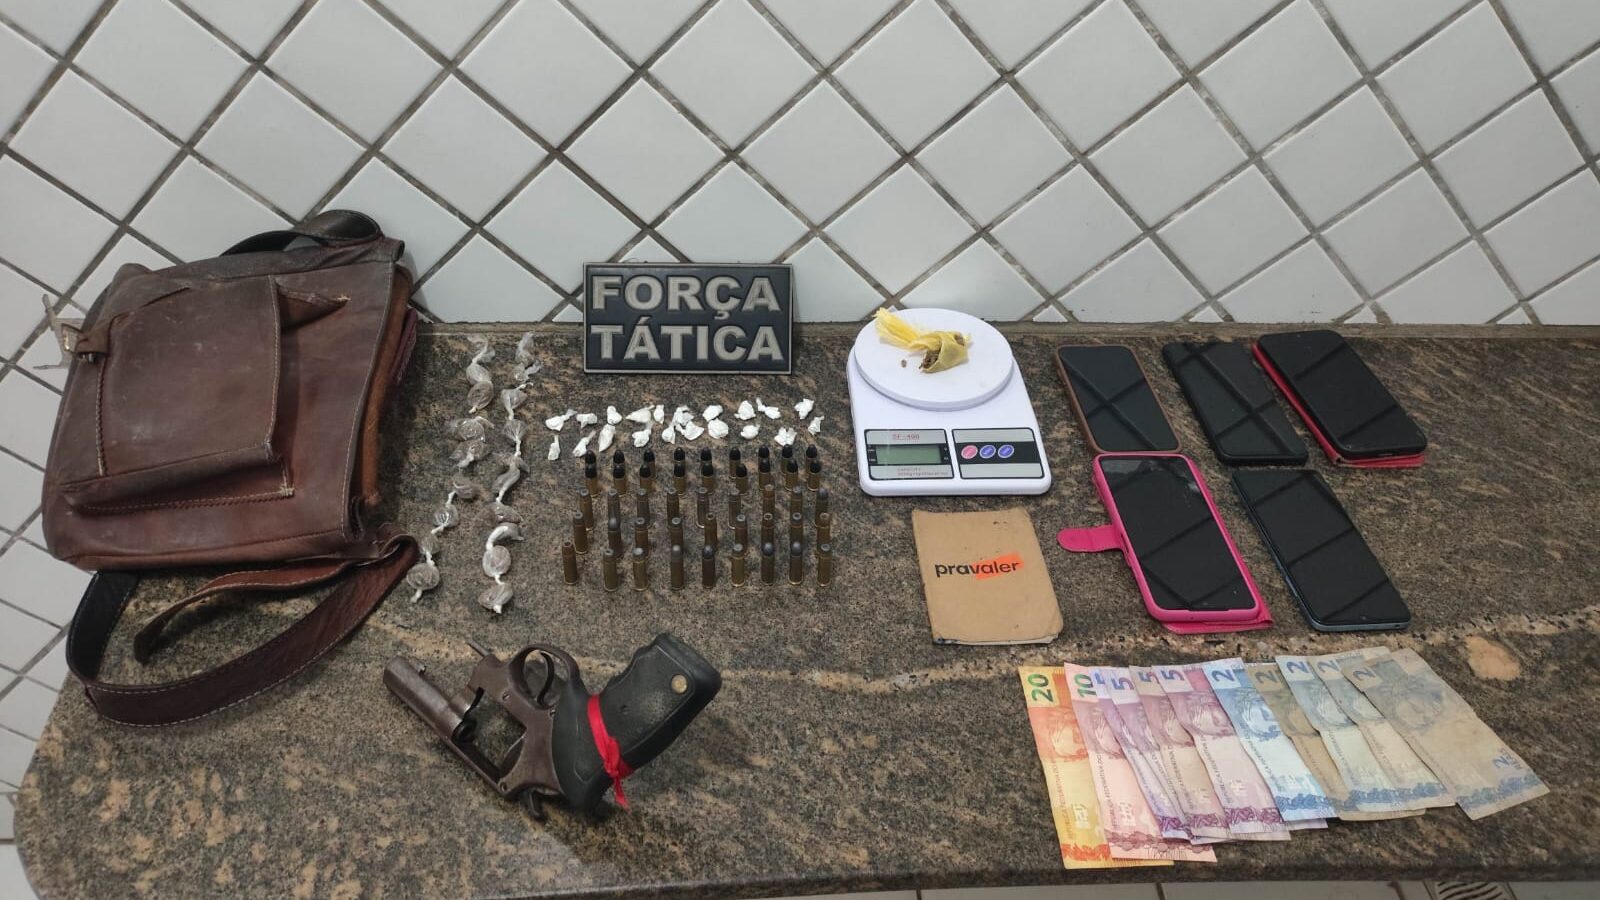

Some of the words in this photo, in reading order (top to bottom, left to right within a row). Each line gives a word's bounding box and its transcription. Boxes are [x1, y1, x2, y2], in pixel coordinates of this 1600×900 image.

[592, 275, 782, 321] FORÇA
[590, 315, 784, 361] TÁTICA
[934, 560, 1020, 578] pravaler
[1286, 661, 1310, 674] 2
[1317, 660, 1340, 673] 2
[1353, 665, 1376, 681] 2
[1160, 669, 1184, 681] 5
[1211, 669, 1236, 682] 2
[1255, 669, 1278, 684] 2
[1027, 673, 1054, 703] 20
[1074, 673, 1097, 698] 10
[1111, 676, 1135, 690] 5
